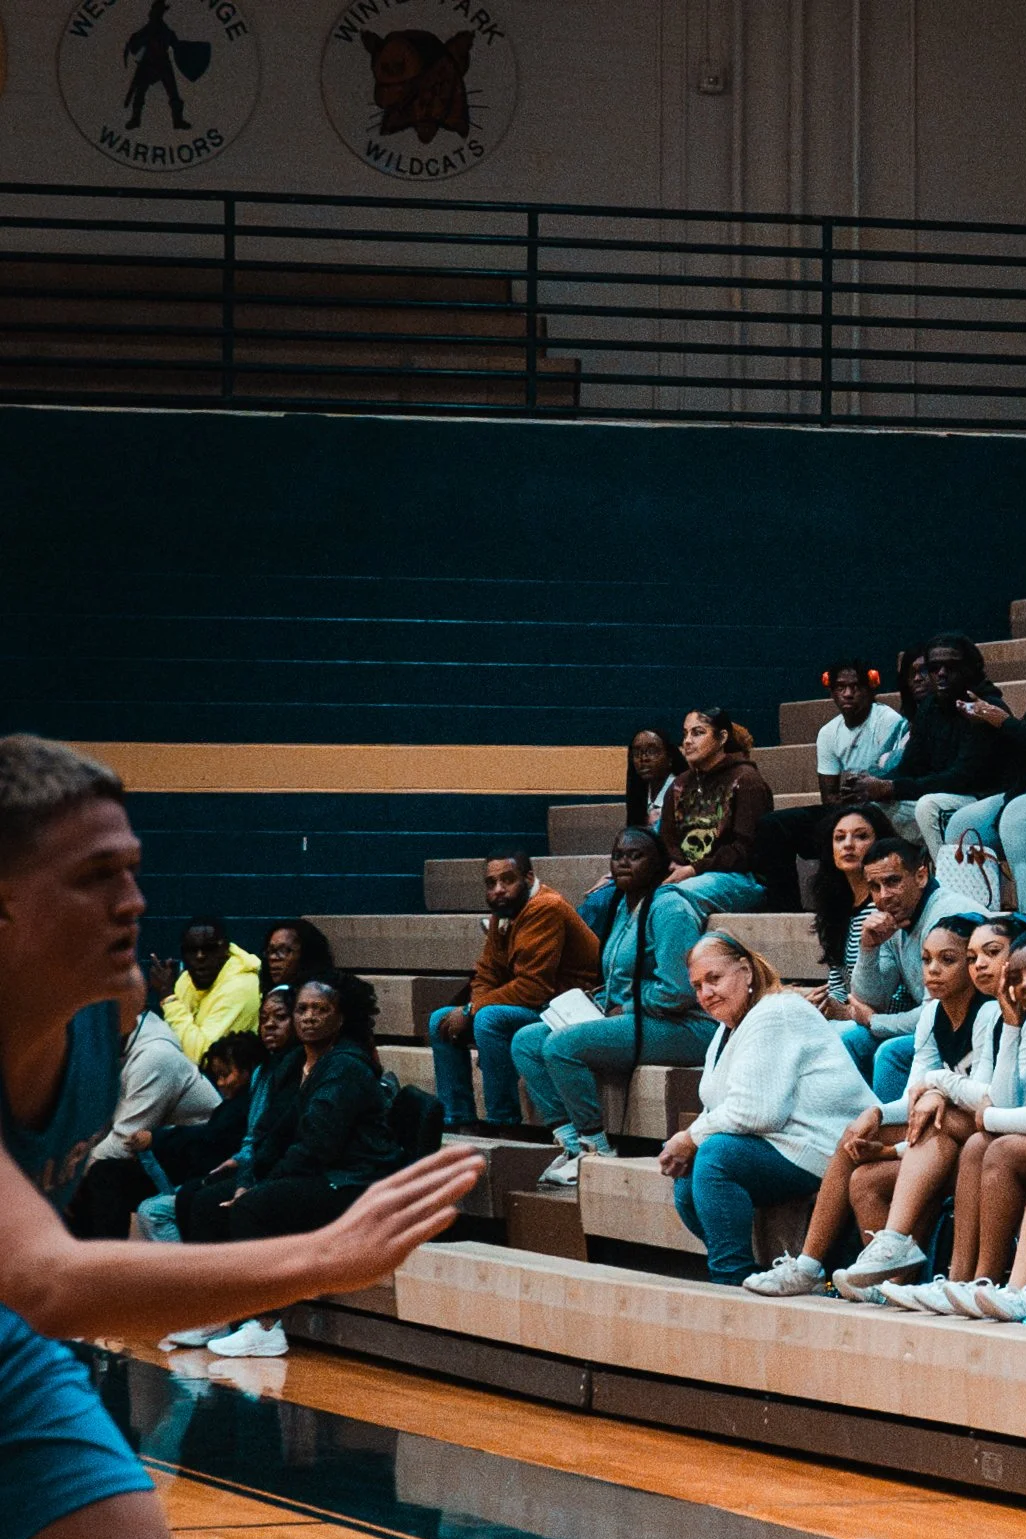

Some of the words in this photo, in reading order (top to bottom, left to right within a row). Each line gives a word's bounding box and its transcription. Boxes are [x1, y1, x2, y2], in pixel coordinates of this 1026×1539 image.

[334, 0, 408, 42] WIN
[440, 0, 505, 45] ARK
[99, 125, 225, 165] WARRIORS
[365, 139, 485, 177] WILDCATS
